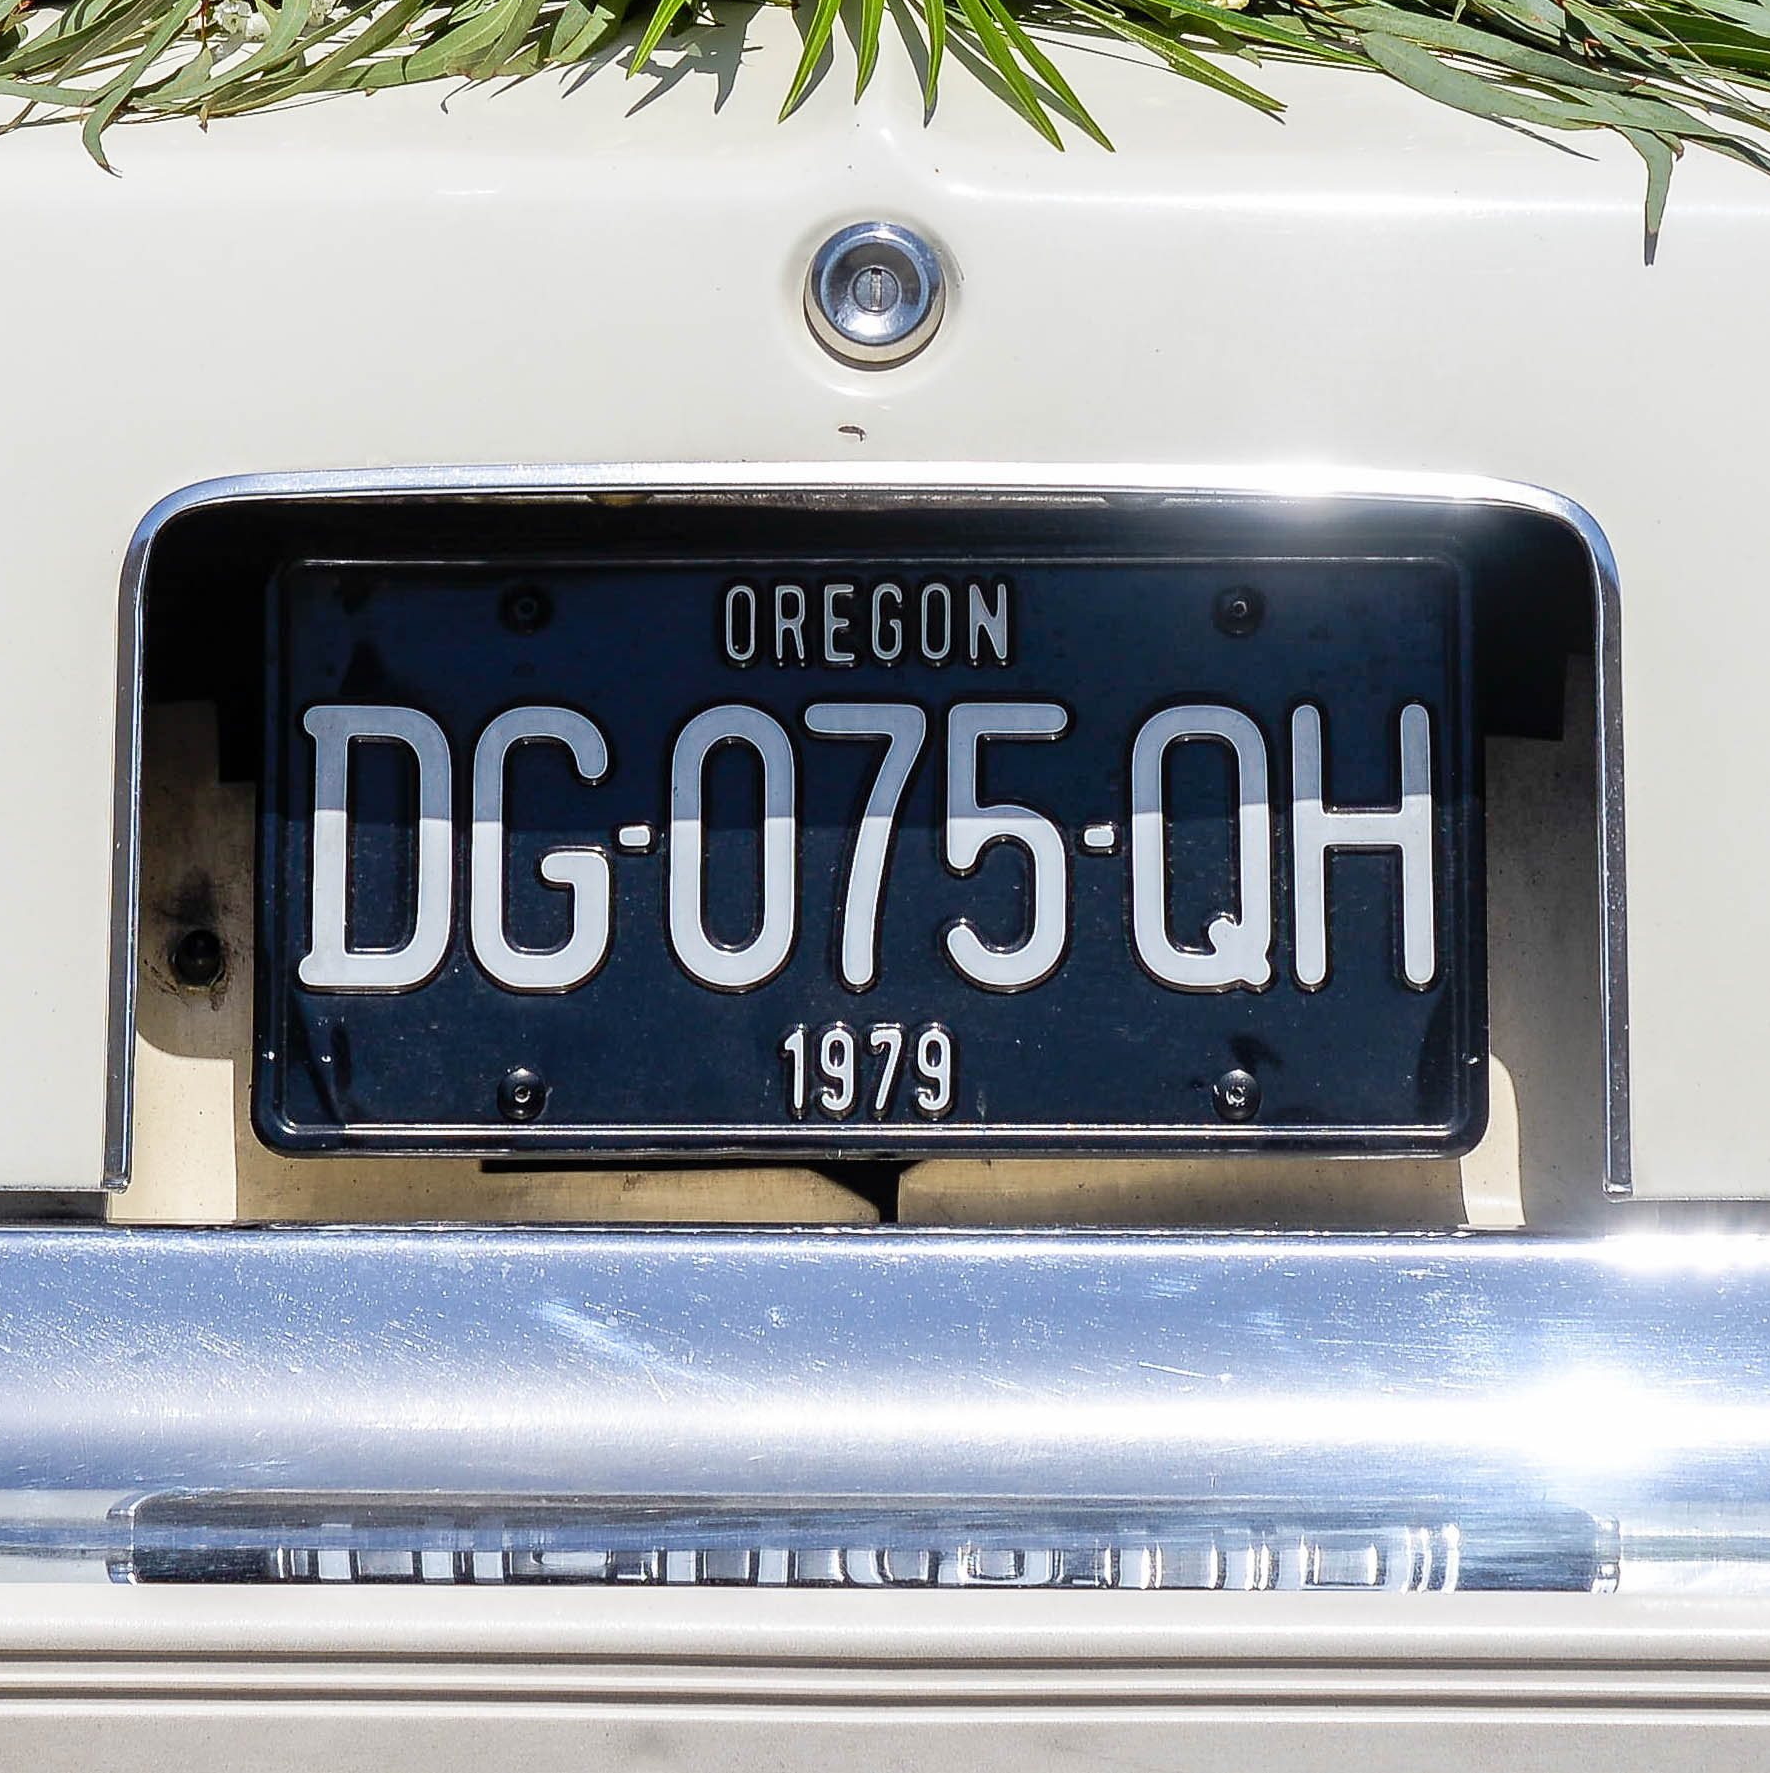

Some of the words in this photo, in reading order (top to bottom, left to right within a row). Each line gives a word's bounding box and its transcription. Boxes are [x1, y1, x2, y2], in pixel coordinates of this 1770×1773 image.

[724, 582, 1009, 664] OREGON
[300, 704, 1436, 989] DG-075-QH
[782, 1025, 953, 1116] 1979
